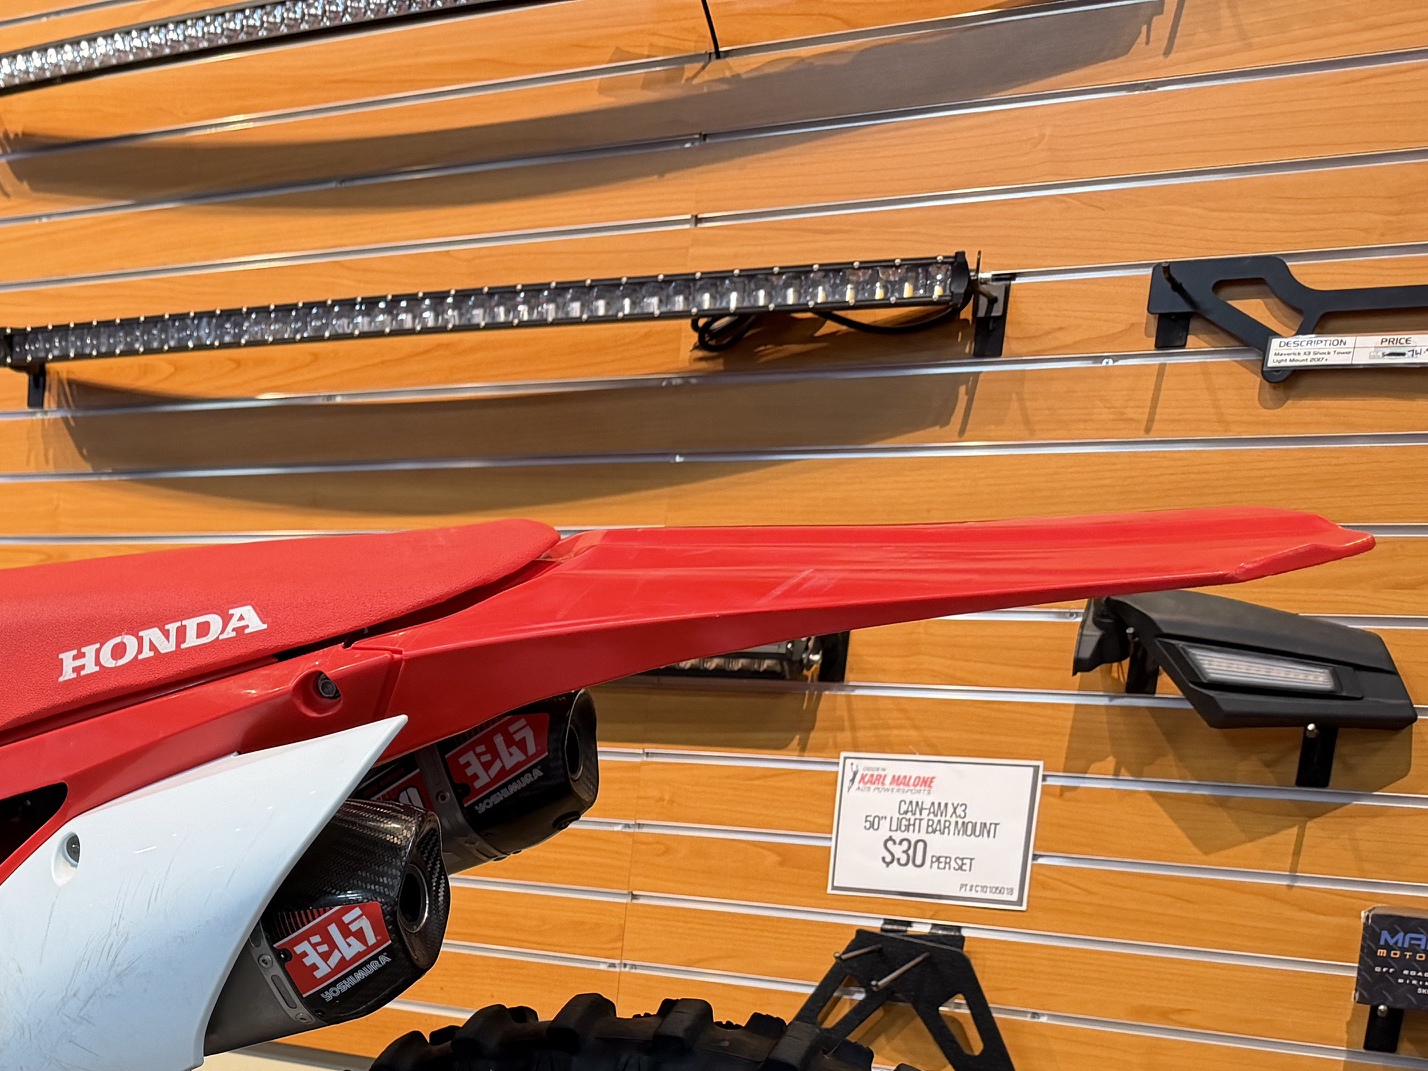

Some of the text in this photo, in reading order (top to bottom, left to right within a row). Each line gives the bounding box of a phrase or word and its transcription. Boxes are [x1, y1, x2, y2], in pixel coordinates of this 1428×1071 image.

[1278, 338, 1347, 348] DESCRIPTION
[1380, 336, 1412, 346] PRICE
[57, 604, 268, 683] HONDA
[858, 772, 937, 789] KARL MALONE
[474, 767, 543, 815] YOSHIMURA
[898, 799, 968, 819] CAN-AM X3
[888, 817, 925, 834] LIGHT
[926, 819, 952, 836] BAR
[953, 821, 1001, 839] MOUNT
[881, 835, 976, 873] $30 PER SET
[1380, 930, 1428, 950] MA
[320, 953, 392, 1002] YOSHIMURA
[1375, 966, 1395, 974] OFF
